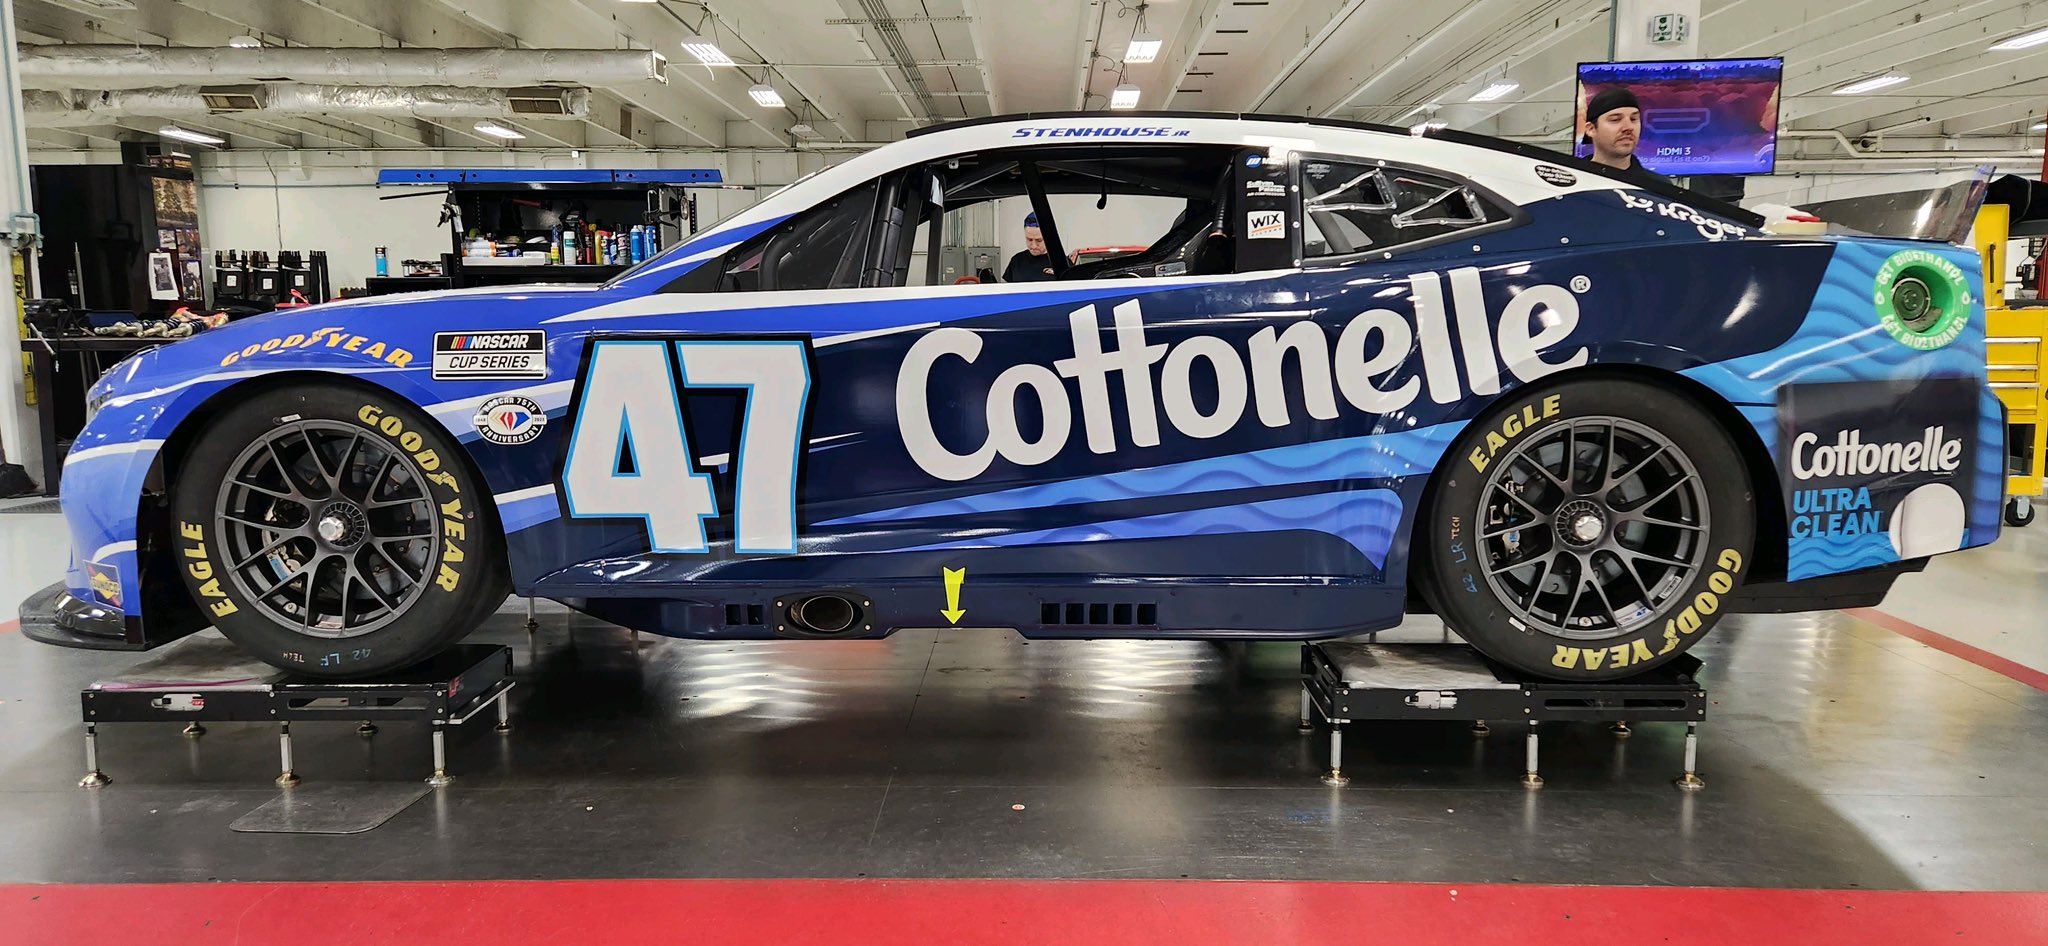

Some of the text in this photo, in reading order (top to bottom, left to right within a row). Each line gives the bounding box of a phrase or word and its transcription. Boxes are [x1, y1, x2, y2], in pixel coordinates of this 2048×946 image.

[1012, 127, 1173, 138] STENHOUSE
[1657, 147, 1691, 155] HDMI 3
[1251, 213, 1281, 228] WIX
[1658, 202, 1747, 240] Kroger
[1876, 250, 1965, 286] GET BIOETHANOL
[470, 334, 529, 349] NASCAR
[1882, 314, 1968, 349] GET BIOETHANOL
[220, 326, 414, 369] GOODYEAR
[449, 355, 530, 369] CUP SERIES
[483, 397, 538, 413] NASCAR 75TH
[481, 426, 539, 443] ANNIVERSARY
[562, 341, 811, 553] 47
[1468, 394, 1561, 473] EAGLE
[1791, 425, 1962, 480] Cottonelle
[1793, 486, 1872, 514] ULTRA
[1791, 510, 1880, 539] CLEAN
[1450, 542, 1468, 564] LR
[180, 521, 239, 618] EAGLE
[320, 653, 340, 666] LF
